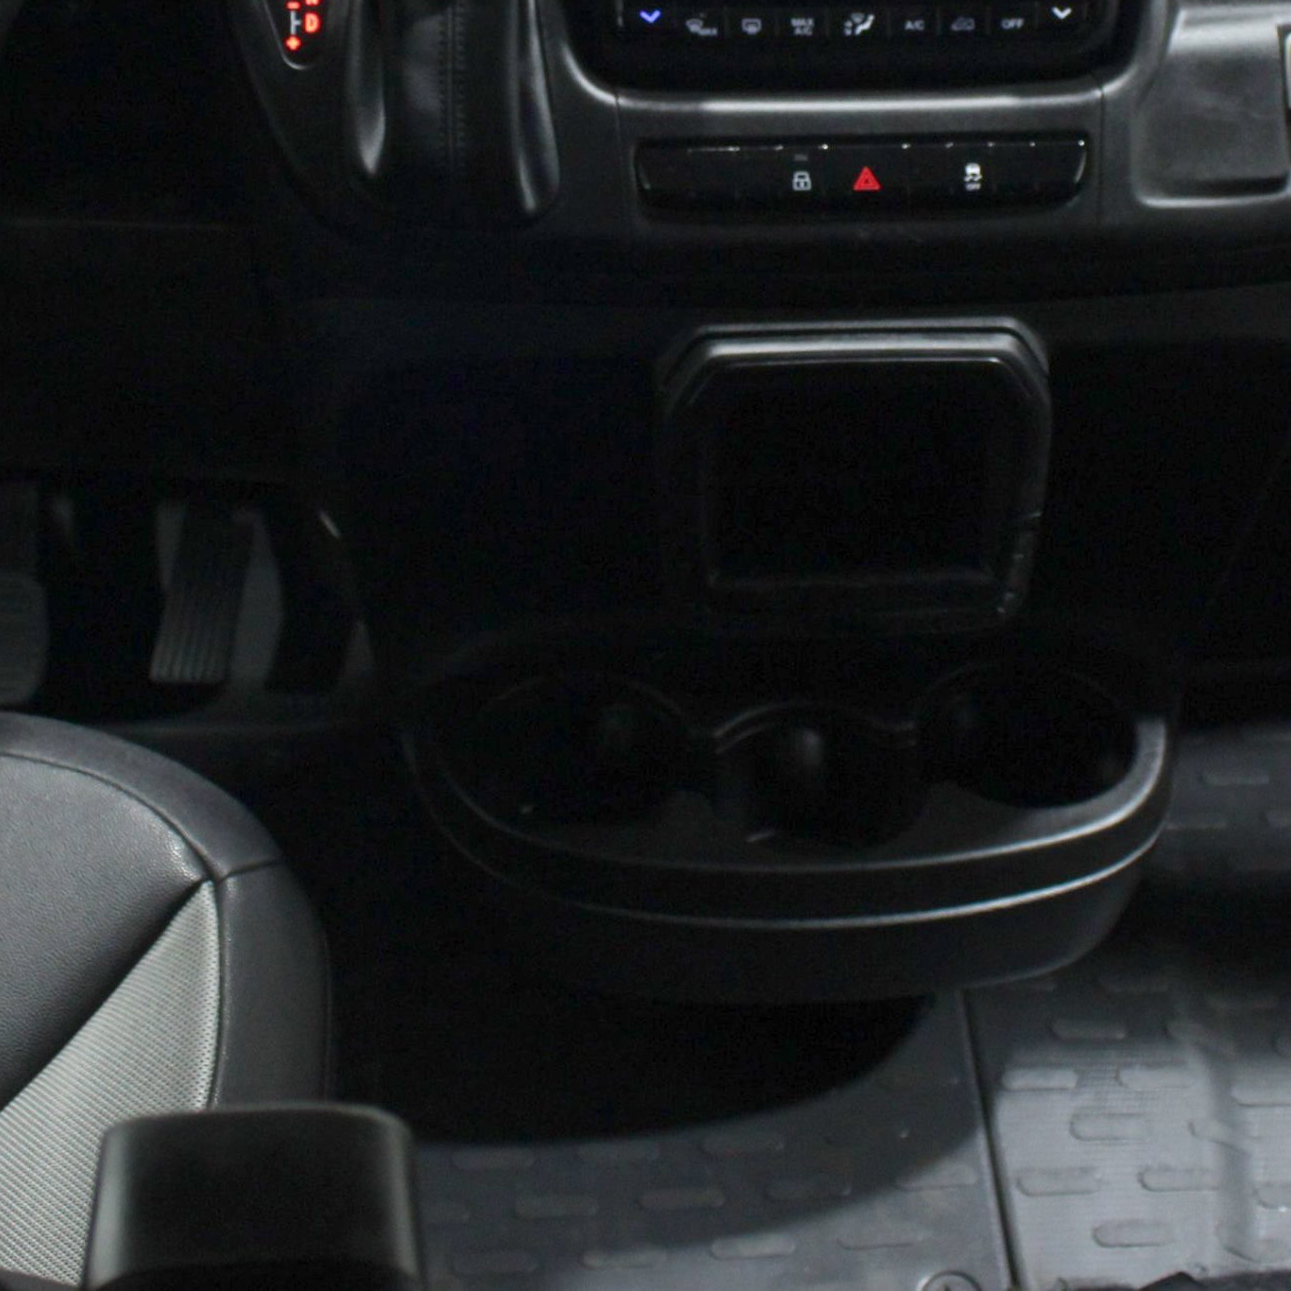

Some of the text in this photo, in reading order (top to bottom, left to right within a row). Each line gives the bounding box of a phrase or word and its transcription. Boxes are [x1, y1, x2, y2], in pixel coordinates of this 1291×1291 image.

[305, 12, 321, 34] D
[791, 18, 814, 27] MAX
[905, 20, 925, 31] A/C
[1001, 18, 1025, 30] OFF
